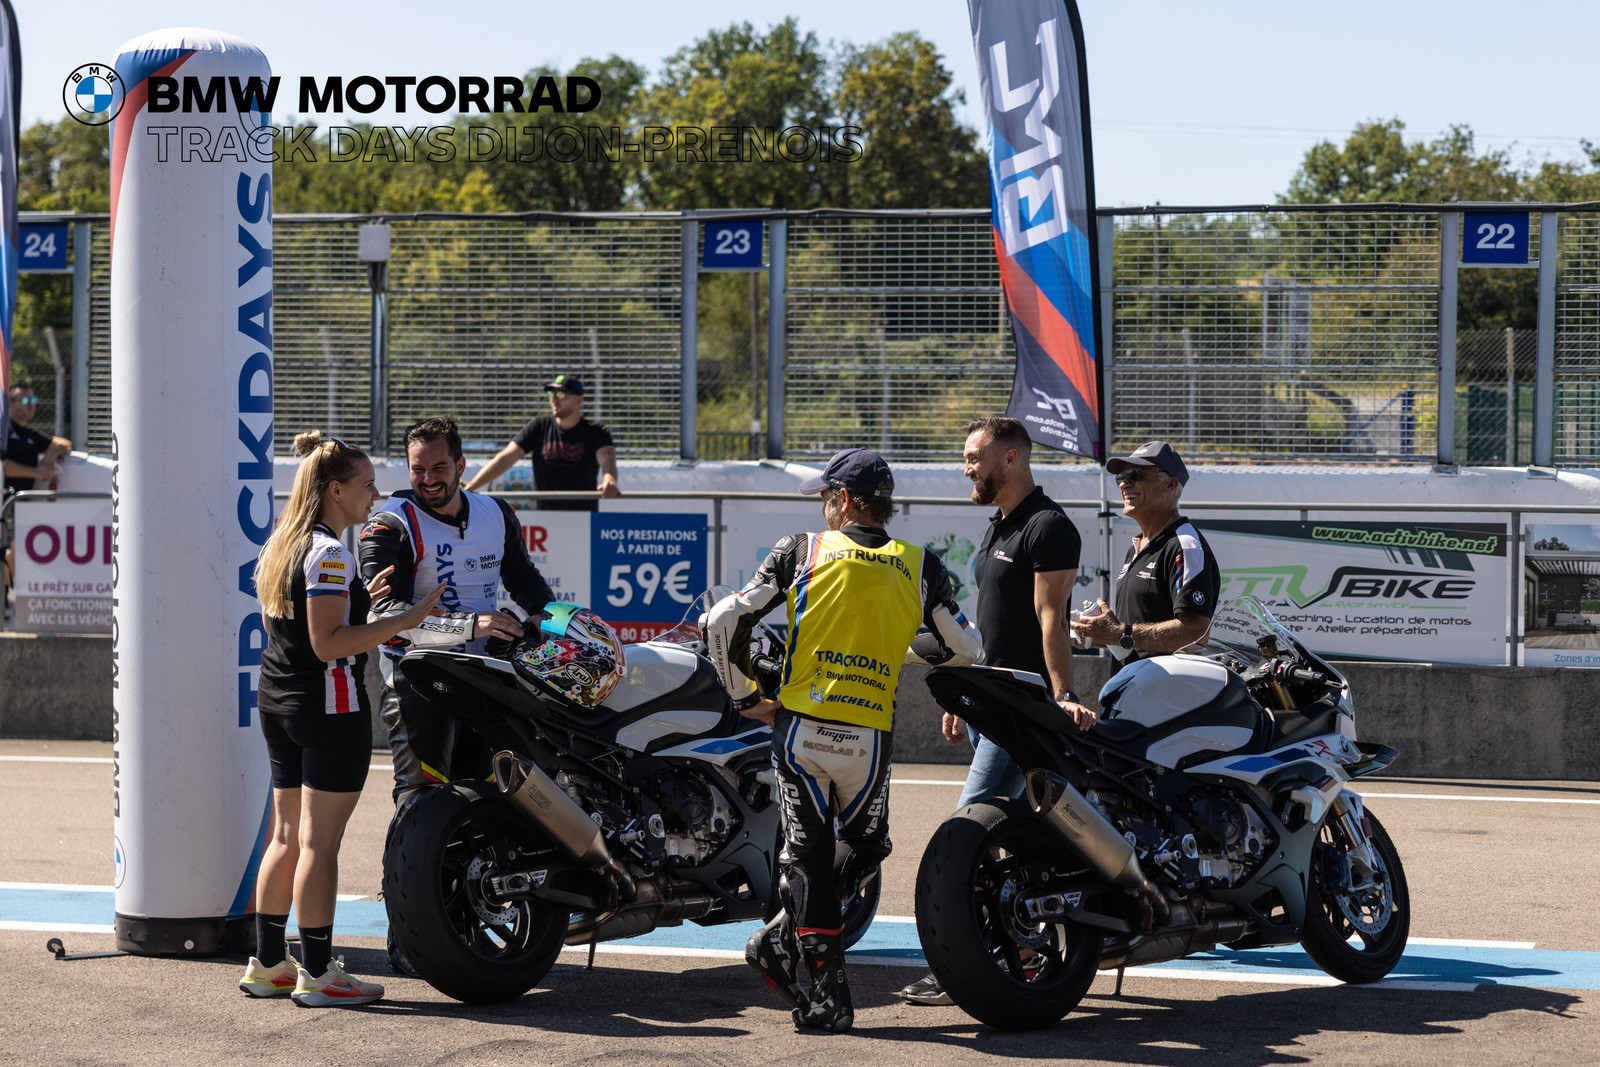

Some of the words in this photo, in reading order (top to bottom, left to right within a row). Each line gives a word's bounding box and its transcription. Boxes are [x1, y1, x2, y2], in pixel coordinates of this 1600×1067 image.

[24, 232, 57, 258] 24
[715, 229, 752, 255] 23
[1476, 223, 1516, 250] 22
[600, 529, 625, 540] NOS
[627, 530, 698, 542] PRESTATIONS
[1313, 526, 1498, 553] www.activbike.net
[616, 541, 626, 555] À
[627, 544, 664, 555] PARTIR
[666, 545, 681, 556] DE
[824, 548, 912, 581] INSTRUCTEUR
[28, 582, 40, 593] LE
[71, 582, 94, 594] SUR
[606, 560, 694, 608] 59€
[1314, 625, 1357, 635] Atelier
[1360, 625, 1438, 635] préparation
[1344, 614, 1405, 625] Location
[1407, 615, 1426, 625] de
[1429, 617, 1472, 626] motos
[620, 627, 638, 641] 80
[815, 650, 891, 677] TRACKDAYS
[1553, 653, 1583, 663] Zones
